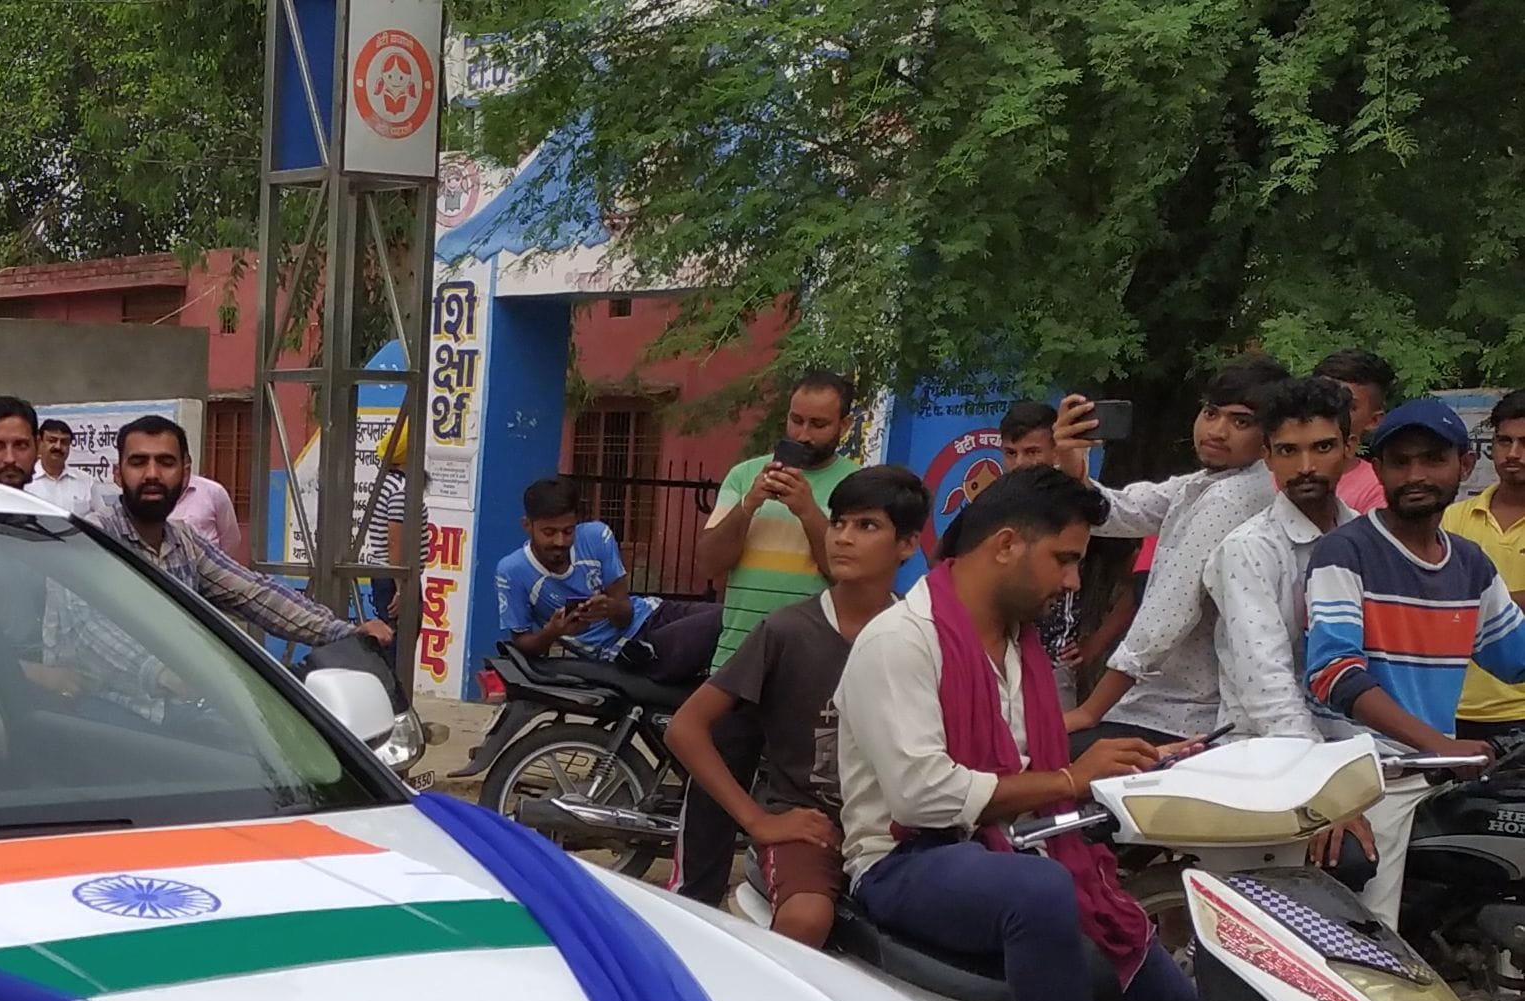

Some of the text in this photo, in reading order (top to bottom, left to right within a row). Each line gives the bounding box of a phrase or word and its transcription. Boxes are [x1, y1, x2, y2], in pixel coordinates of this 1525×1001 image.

[70, 424, 88, 451] ठाते
[954, 433, 1002, 455] बेटी बचा
[1496, 810, 1525, 823] HE
